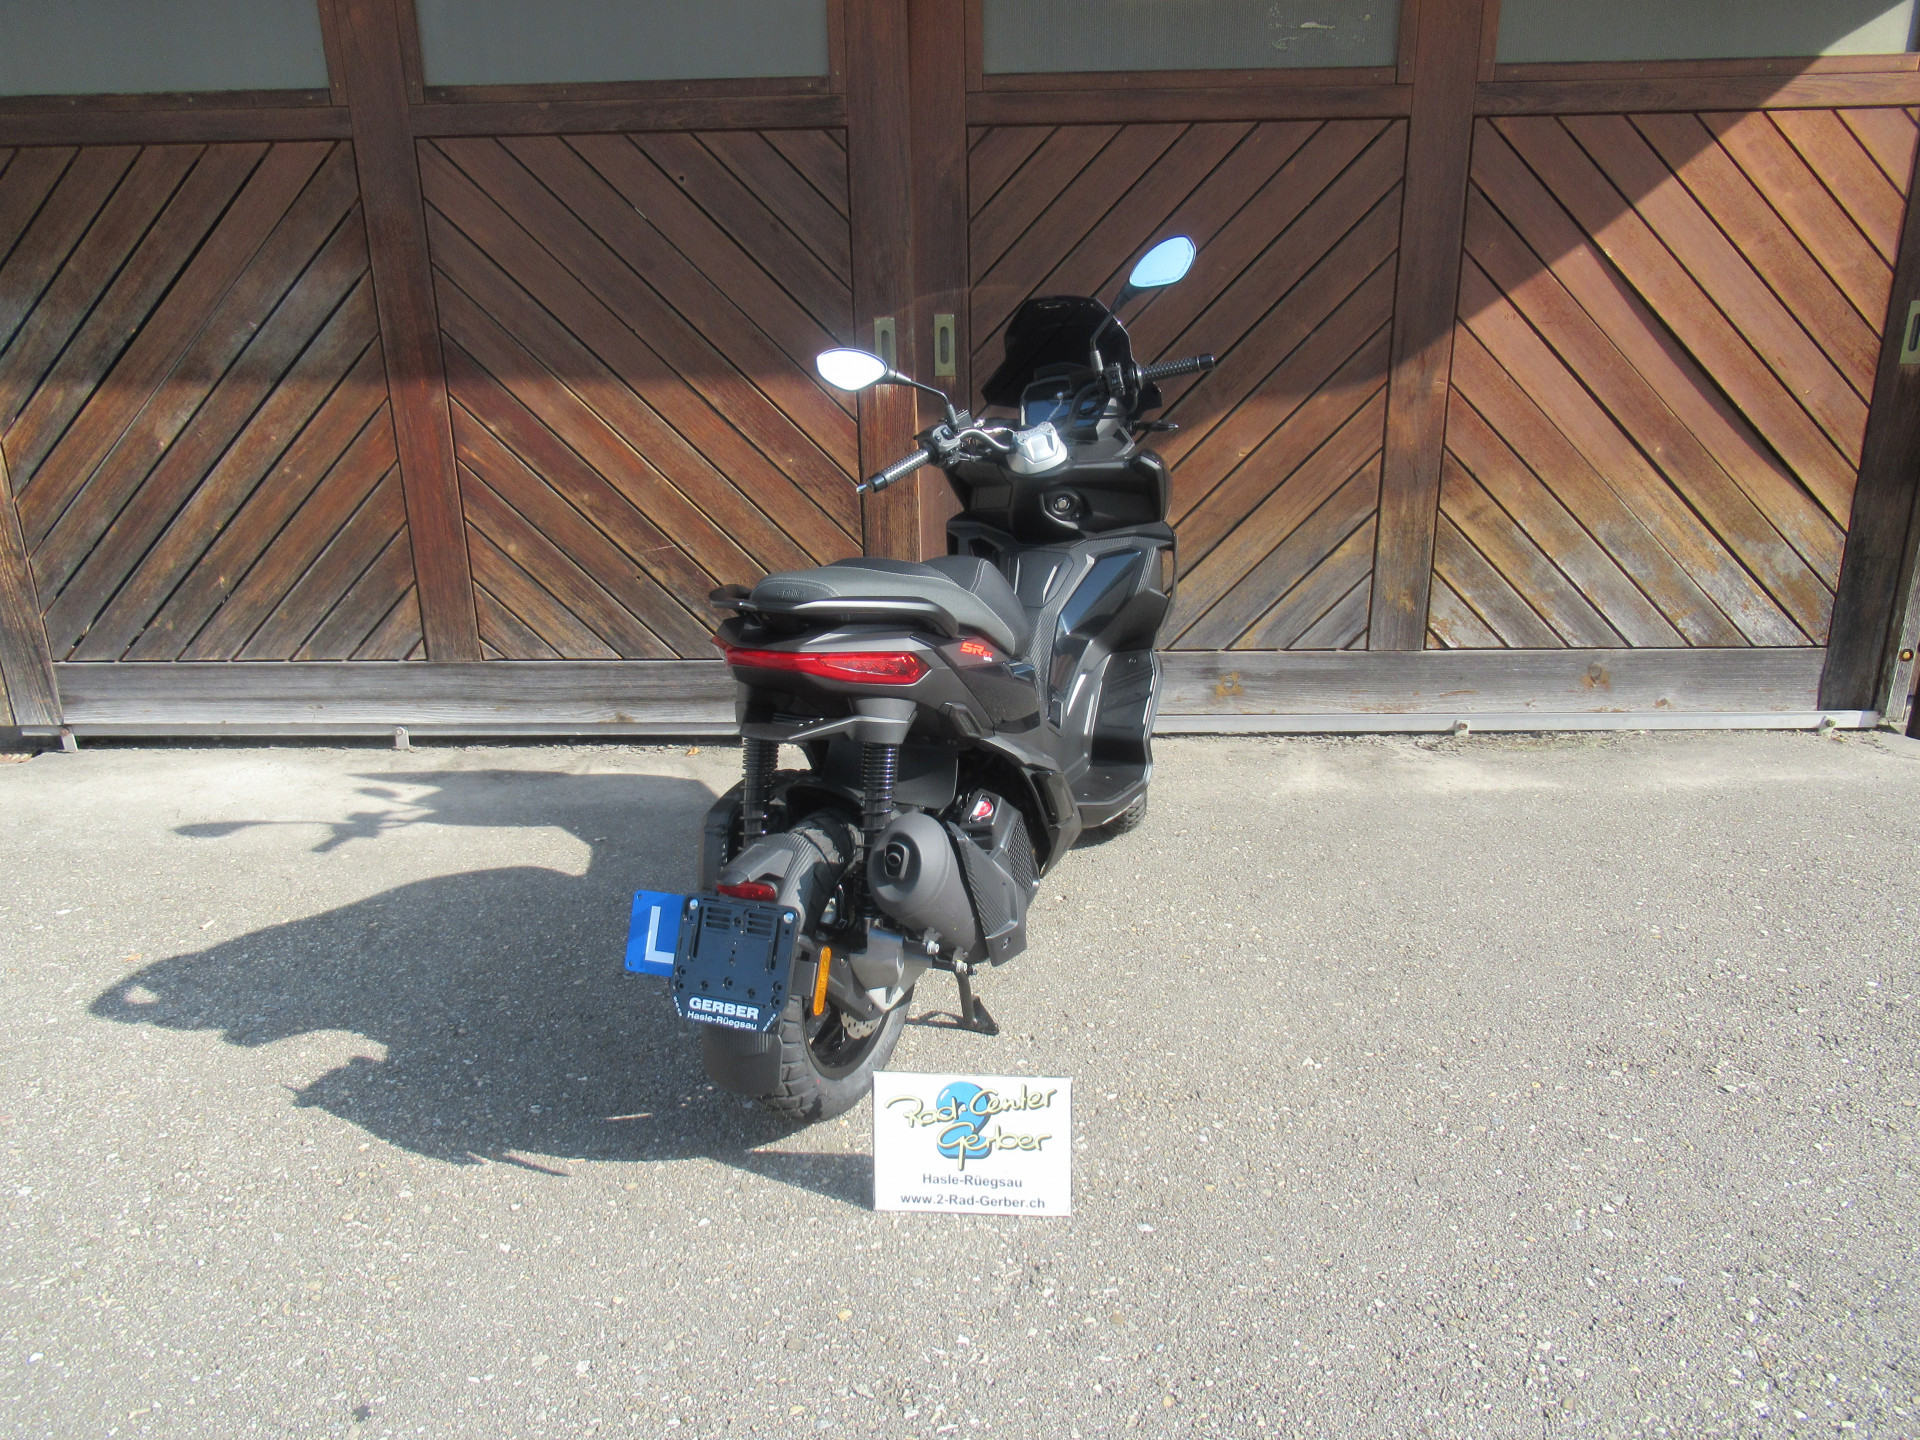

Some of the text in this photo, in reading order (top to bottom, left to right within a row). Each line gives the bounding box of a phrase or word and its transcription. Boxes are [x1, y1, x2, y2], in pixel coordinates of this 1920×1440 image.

[960, 641, 985, 656] SR
[644, 905, 675, 965] L
[689, 997, 760, 1020] GERBER
[687, 1010, 758, 1030] Hasle-Rüegsau
[937, 1121, 1053, 1172] Gerber
[922, 1173, 1023, 1190] Hasle-Rüegsau
[901, 1194, 1046, 1209] www.2-Rad-Gerber.ch
